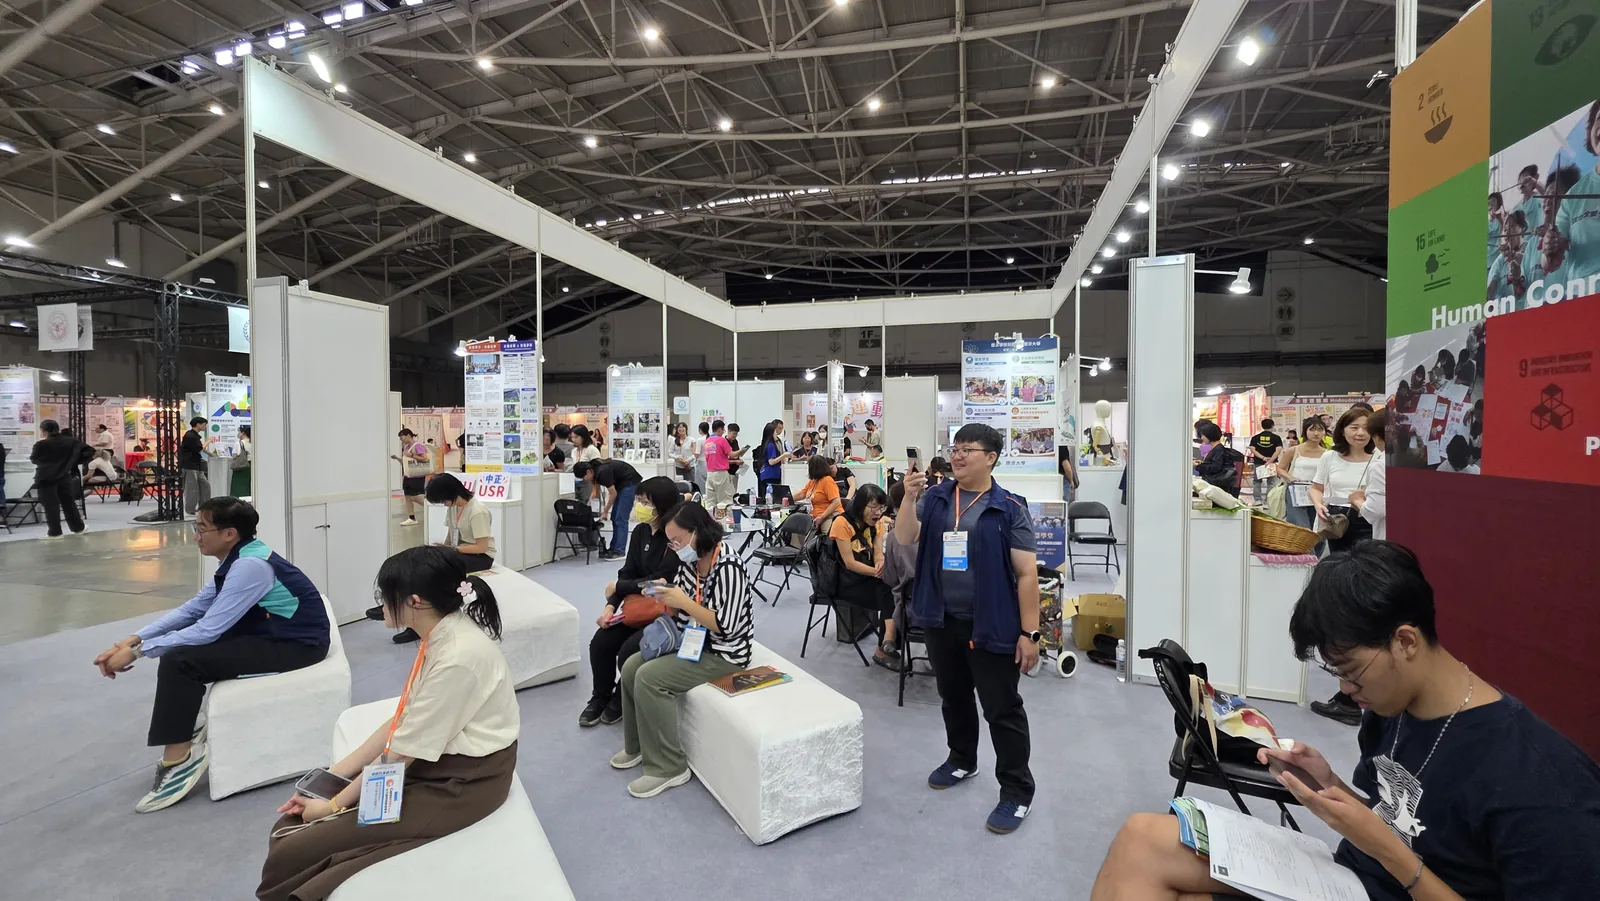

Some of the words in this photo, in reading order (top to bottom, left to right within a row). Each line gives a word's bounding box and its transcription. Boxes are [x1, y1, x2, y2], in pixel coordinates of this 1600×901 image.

[1418, 93, 1424, 111] 2
[1416, 233, 1425, 251] 15
[1431, 294, 1515, 330] Human
[1519, 358, 1528, 378] 9
[485, 474, 502, 484] 中正
[478, 485, 505, 497] USR
